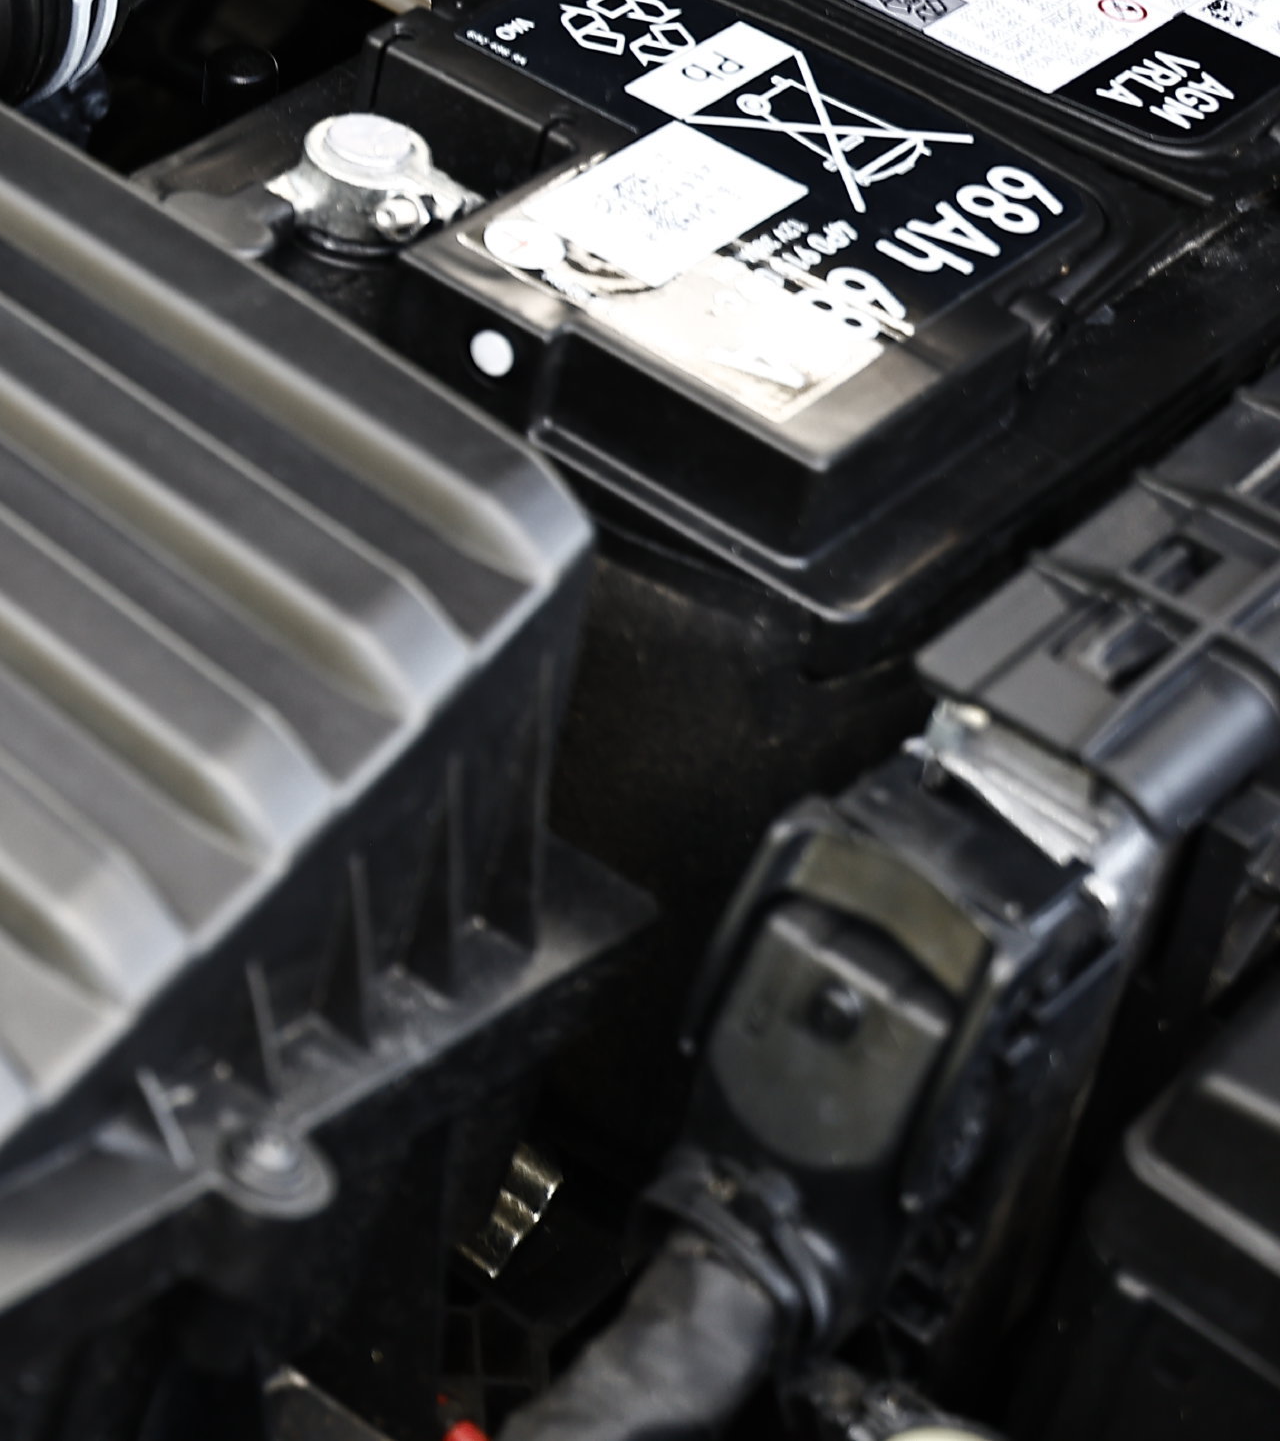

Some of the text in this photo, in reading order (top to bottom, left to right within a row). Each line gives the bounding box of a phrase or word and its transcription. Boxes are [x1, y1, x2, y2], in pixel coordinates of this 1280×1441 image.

[681, 50, 744, 81] Pb
[1096, 50, 1201, 107] VRLA
[1149, 70, 1235, 129] AGM
[875, 165, 1064, 276] 68Ah
